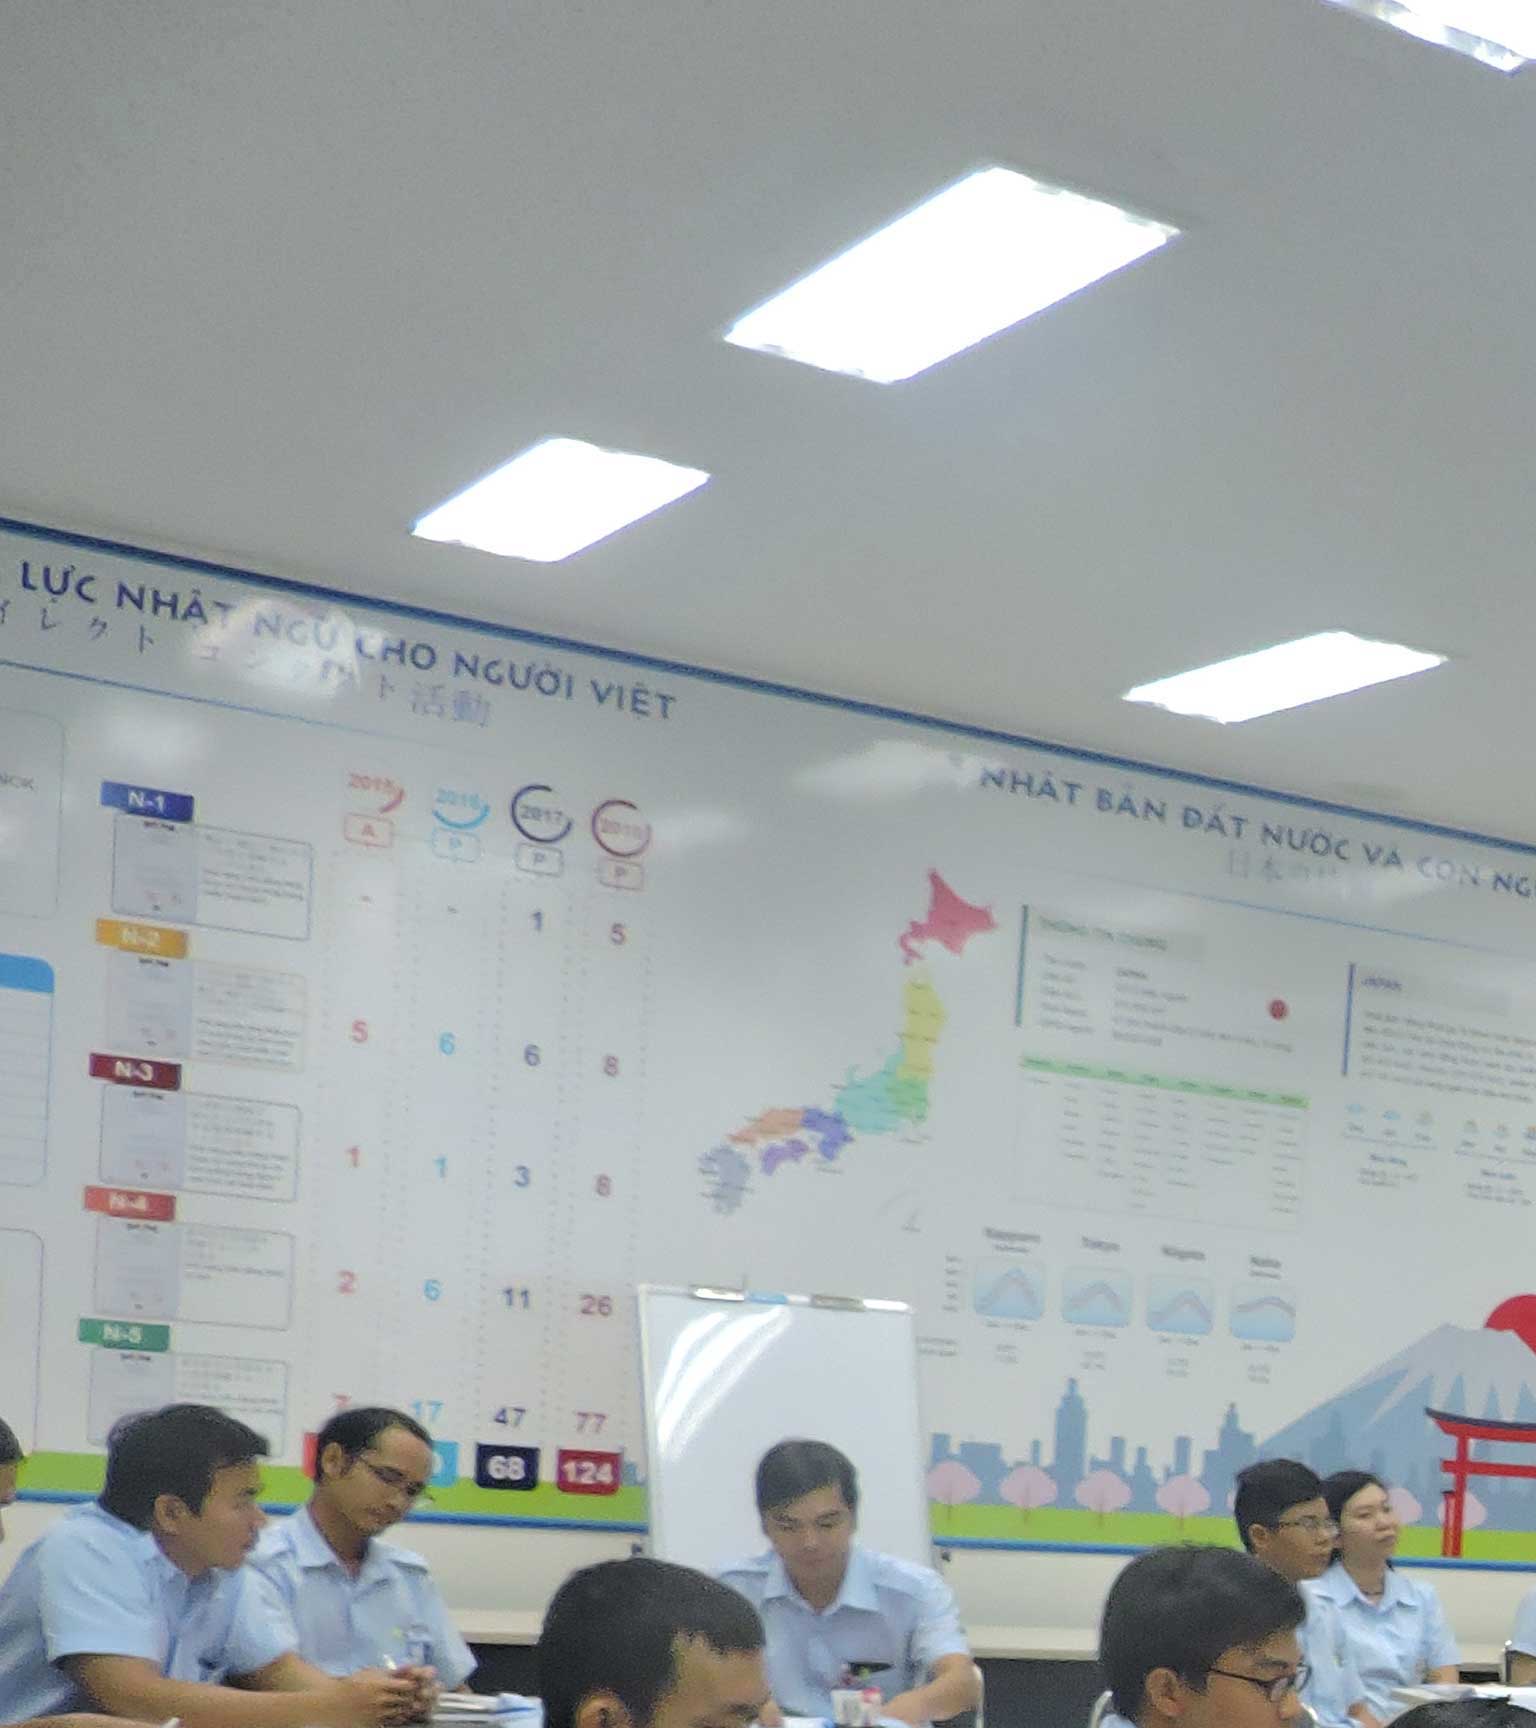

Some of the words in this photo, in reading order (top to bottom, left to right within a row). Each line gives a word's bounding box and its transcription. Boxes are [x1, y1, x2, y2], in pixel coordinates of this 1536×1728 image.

[127, 790, 165, 814] N-1
[611, 923, 626, 945] 5
[350, 1020, 369, 1044] 5
[438, 1031, 456, 1056] 6
[523, 1044, 541, 1067] 6
[603, 1055, 619, 1077] 8
[114, 1059, 154, 1082] N-3
[513, 1164, 530, 1189] 3
[337, 1270, 357, 1294] 2
[423, 1278, 441, 1301] 6
[502, 1287, 531, 1310] 11
[580, 1294, 613, 1317] 26
[411, 1400, 443, 1423] 17
[493, 1407, 527, 1428] 47
[576, 1411, 608, 1434] 77
[487, 1455, 526, 1481] 68
[562, 1459, 614, 1485] 124
